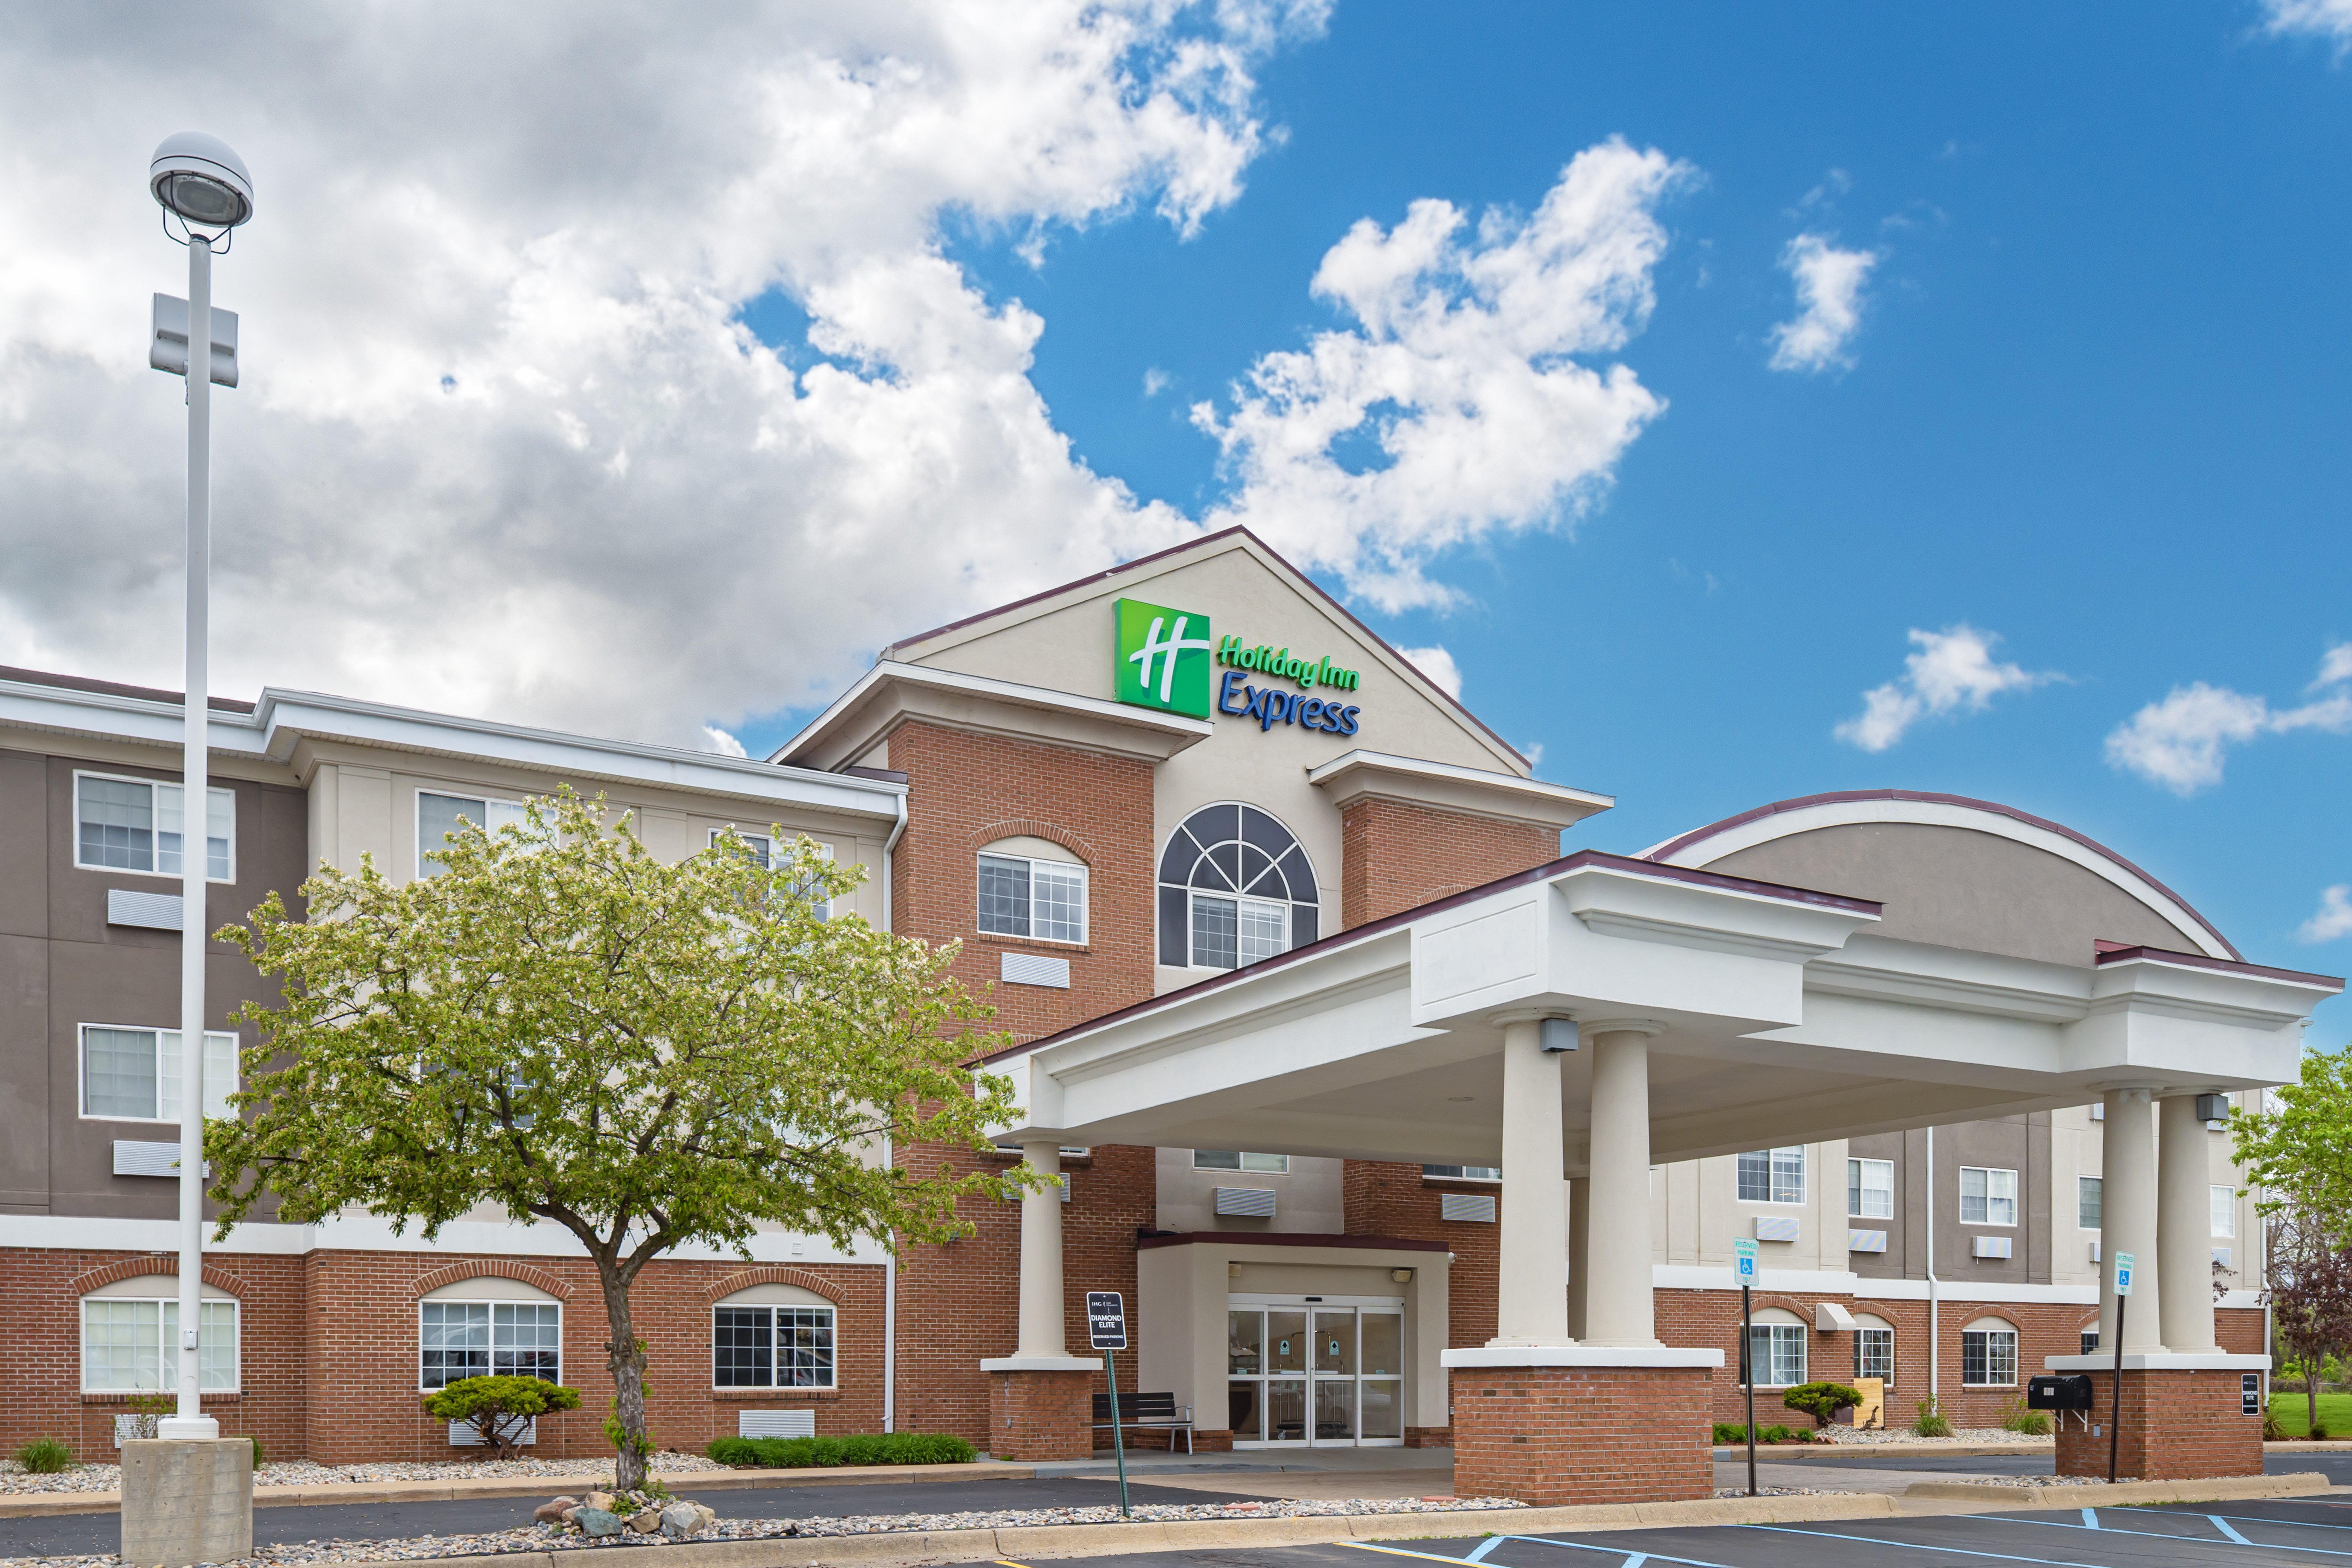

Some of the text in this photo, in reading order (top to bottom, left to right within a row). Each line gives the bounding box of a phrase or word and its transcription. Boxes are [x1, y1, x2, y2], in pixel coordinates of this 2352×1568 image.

[1217, 634, 1360, 691] Holiday Inn
[1218, 671, 1361, 736] Express
